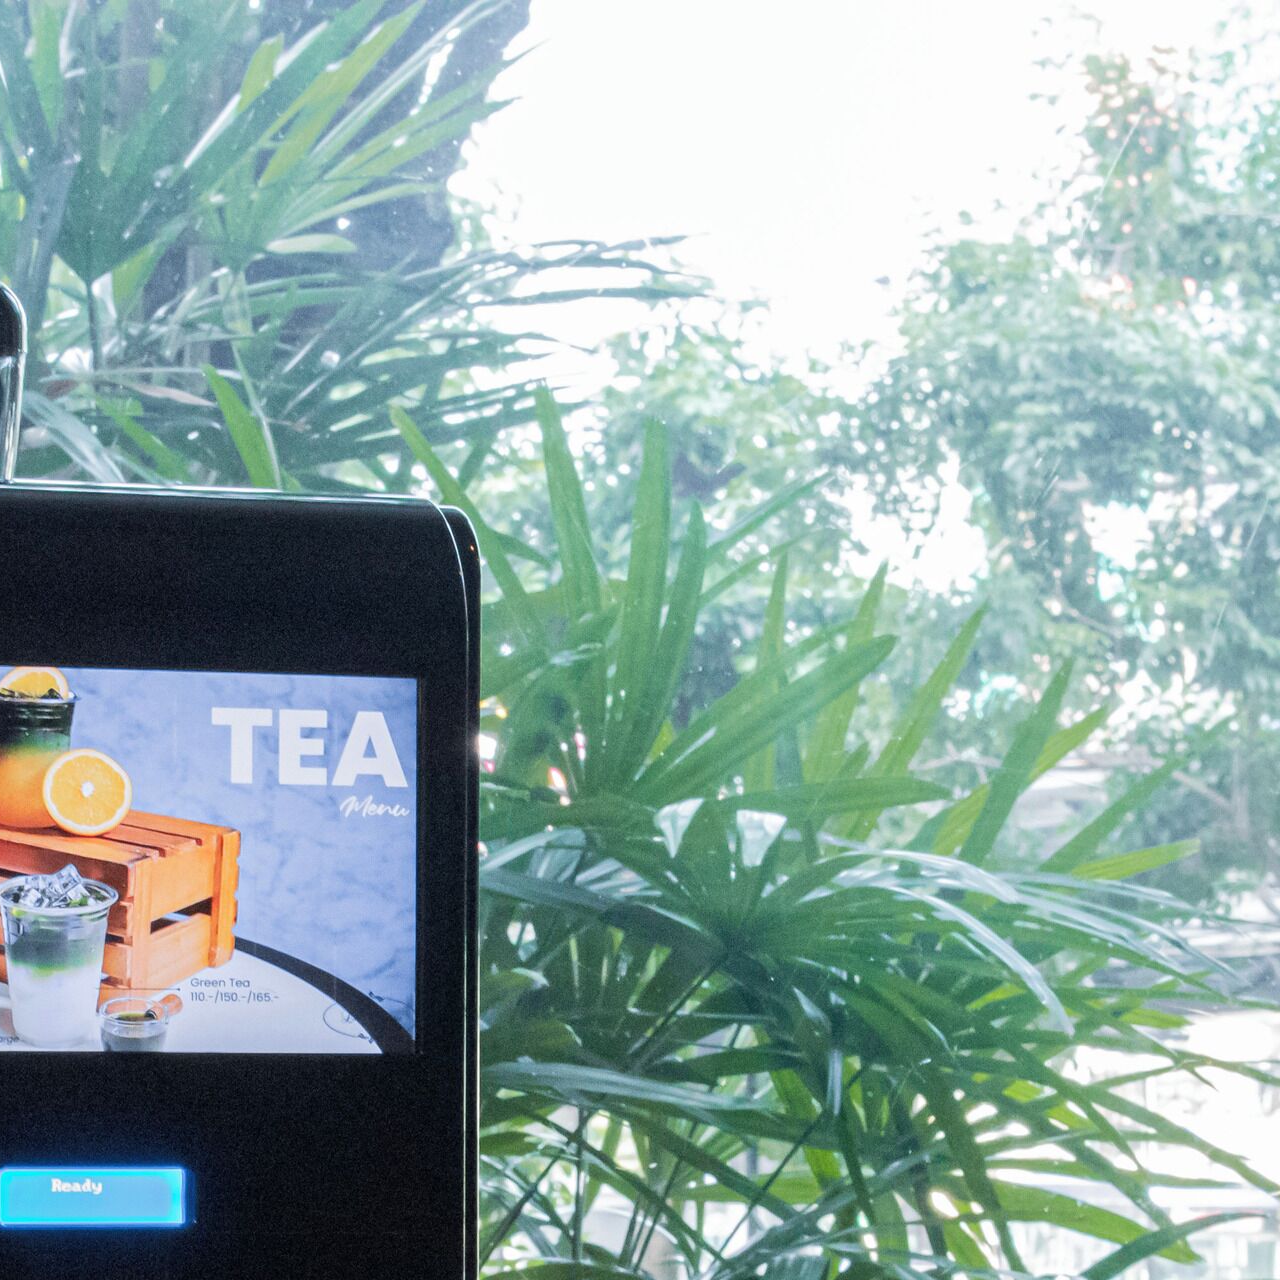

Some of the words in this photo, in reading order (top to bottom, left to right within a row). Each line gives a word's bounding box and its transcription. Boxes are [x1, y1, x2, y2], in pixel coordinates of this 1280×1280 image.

[211, 706, 409, 788] TEA
[339, 795, 410, 817] Menu
[190, 978, 226, 989] Green
[230, 978, 251, 989] Tea
[50, 1177, 103, 1195] Ready
